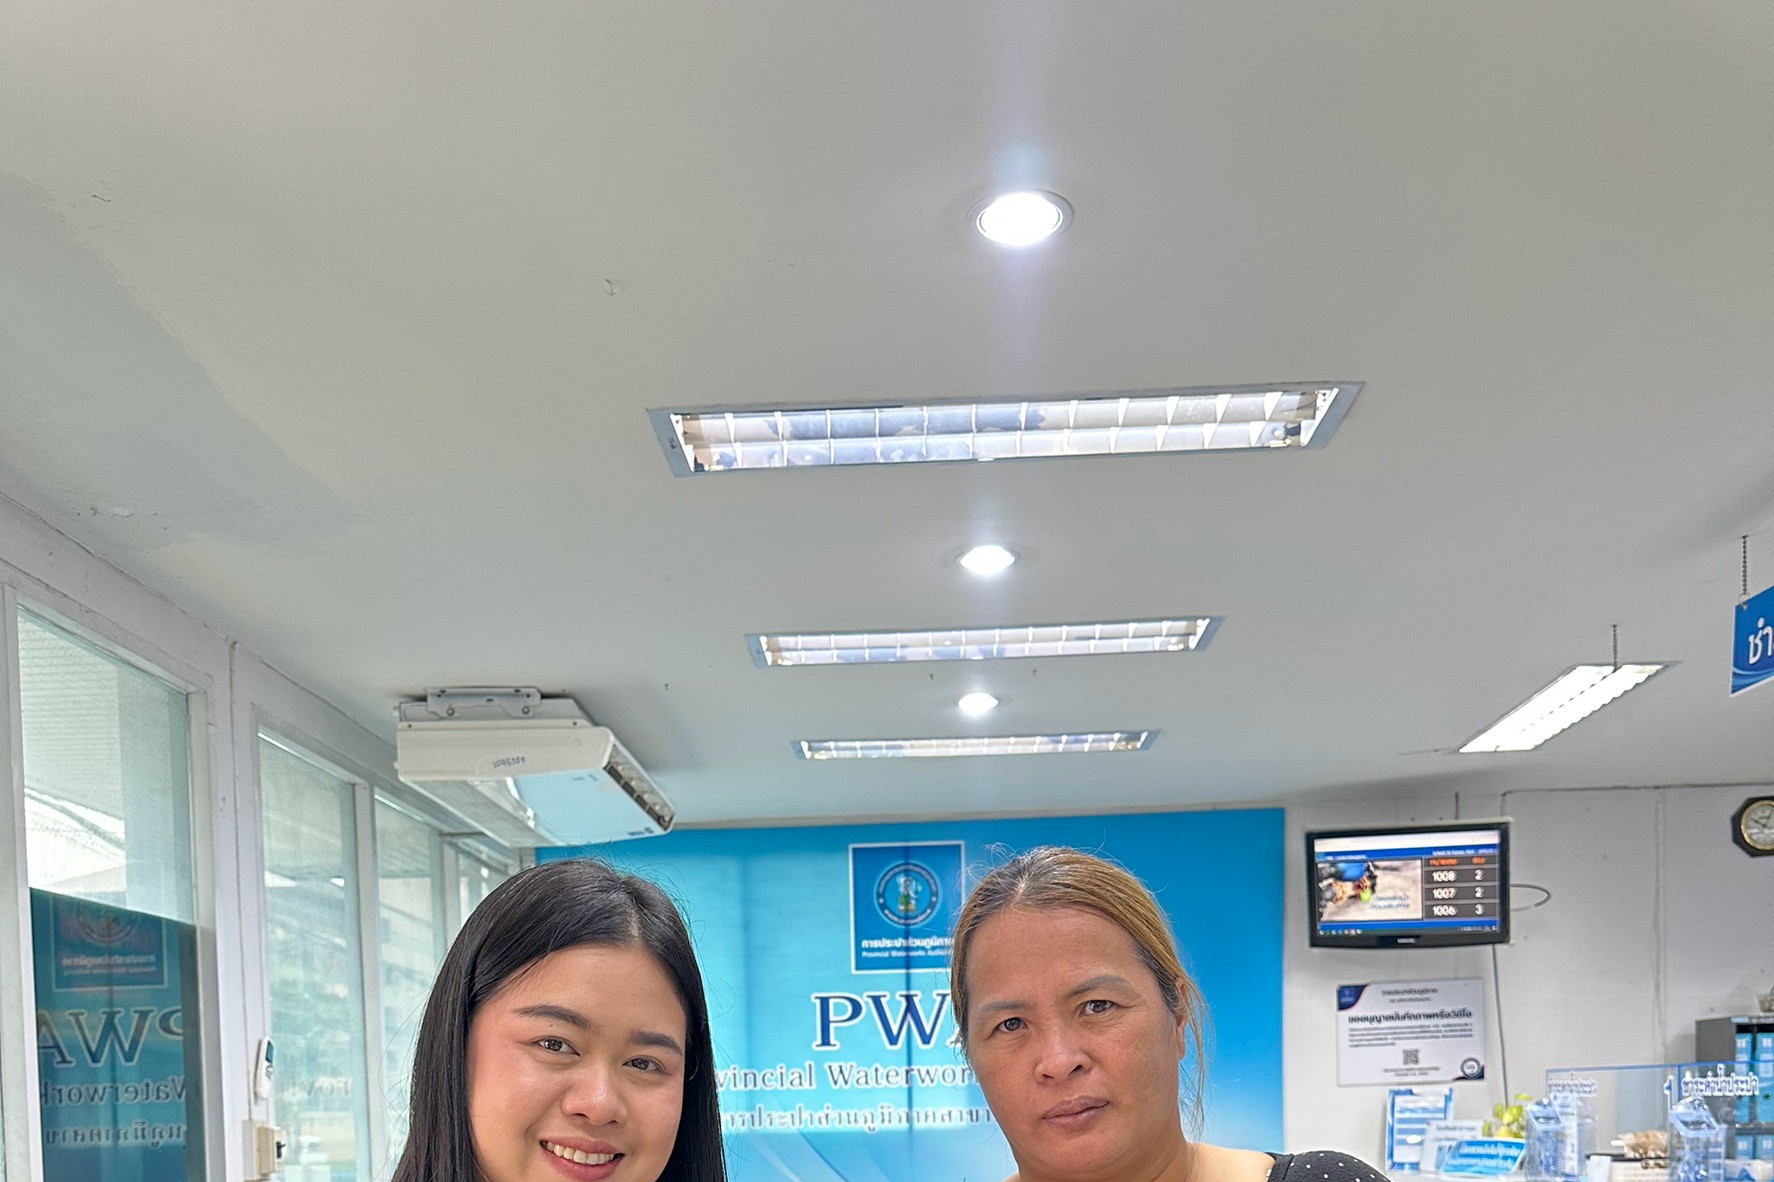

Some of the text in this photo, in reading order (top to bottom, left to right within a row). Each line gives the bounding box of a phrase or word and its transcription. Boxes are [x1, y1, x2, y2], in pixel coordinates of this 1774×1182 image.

[1475, 869, 1483, 880] 2
[1432, 886, 1484, 899] 1007 2
[1475, 903, 1484, 915] 3
[813, 992, 962, 1050] PW
[715, 1062, 814, 1090] vincial
